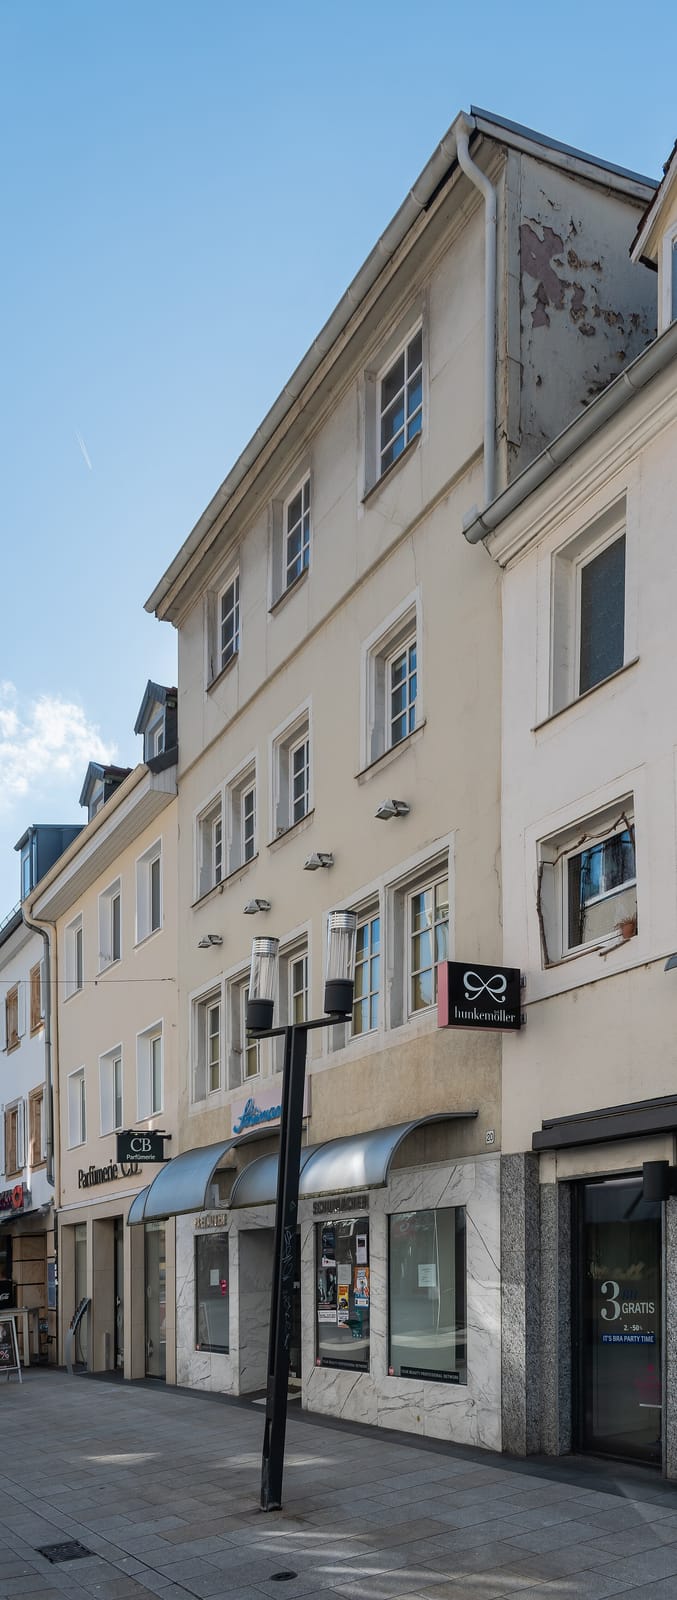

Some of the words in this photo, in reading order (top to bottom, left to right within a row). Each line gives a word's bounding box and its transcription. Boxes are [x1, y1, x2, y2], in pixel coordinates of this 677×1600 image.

[454, 1005, 516, 1023] hunkemöller
[130, 1137, 152, 1152] CB
[126, 1153, 156, 1161] Parfümerie
[78, 1159, 118, 1189] Parfümerie
[621, 1302, 655, 1314] GRATIS
[641, 1335, 654, 1343] TIME
